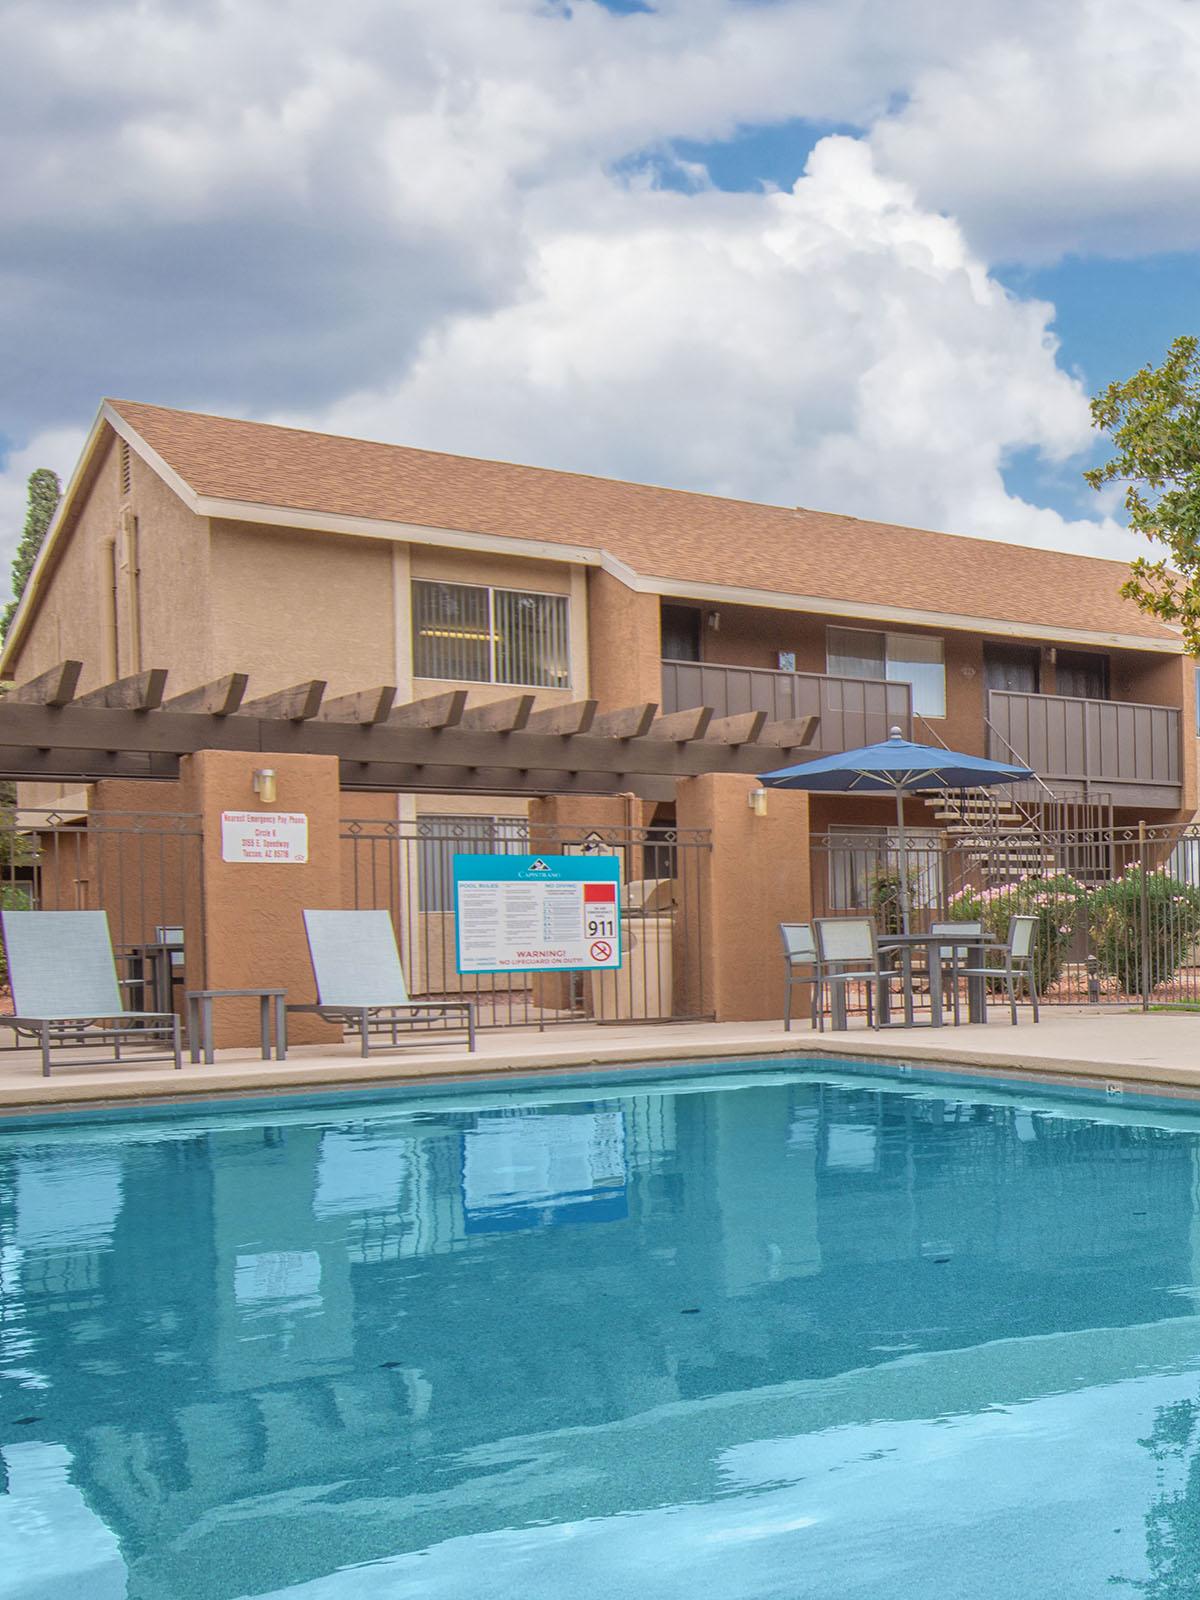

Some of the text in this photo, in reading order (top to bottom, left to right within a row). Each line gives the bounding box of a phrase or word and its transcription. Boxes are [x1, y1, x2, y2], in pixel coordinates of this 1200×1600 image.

[224, 815, 245, 823] Nearest
[247, 814, 276, 824] Emergency
[277, 815, 287, 824] Pay
[255, 828, 271, 837] Circle
[263, 839, 289, 849] Speedway
[264, 849, 272, 858] AZ
[588, 920, 613, 937] 911
[516, 950, 566, 958] WARNING!
